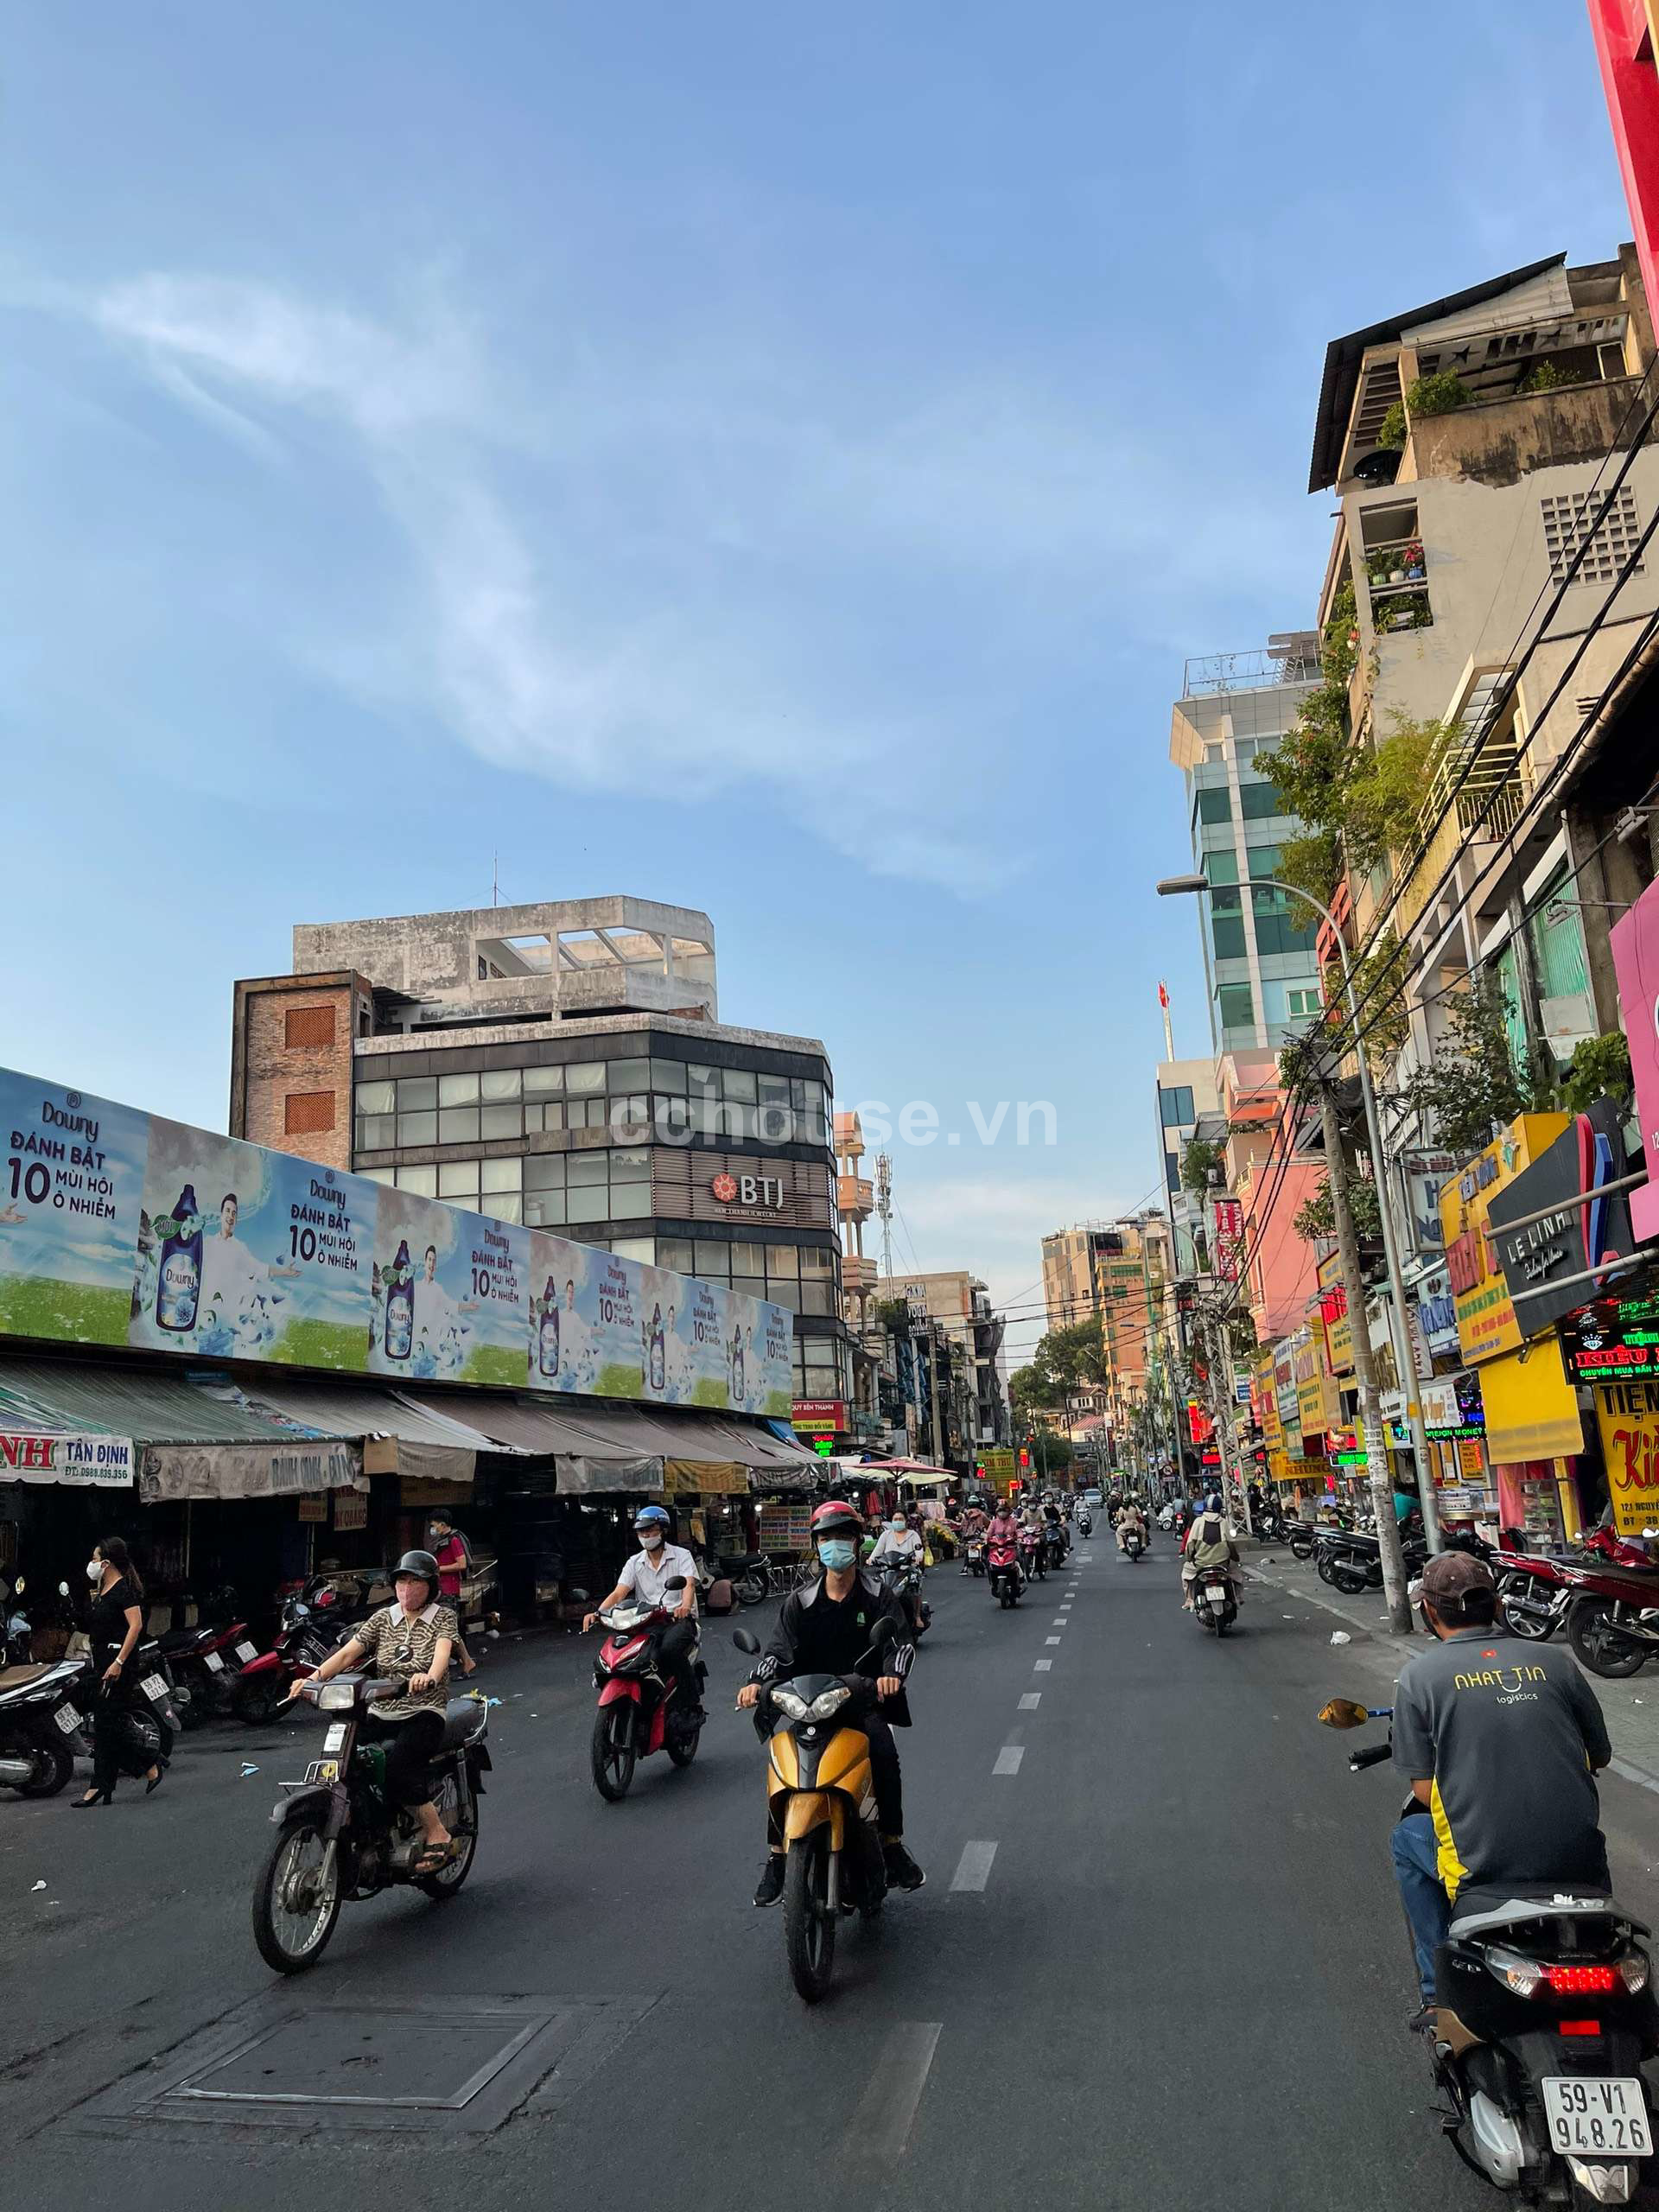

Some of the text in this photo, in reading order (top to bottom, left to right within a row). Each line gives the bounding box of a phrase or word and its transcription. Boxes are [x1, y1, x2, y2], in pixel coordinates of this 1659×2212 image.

[41, 1101, 99, 1143] Downy
[10, 1131, 105, 1172] ĐÁNH BẬT
[8, 1157, 50, 1204] 10
[55, 1169, 113, 1196] MÙI HÔI
[310, 1179, 346, 1211] Downy
[741, 1175, 784, 1209] BTJ
[53, 1190, 116, 1220] Ô NHIỄM
[290, 1204, 351, 1233] ĐÁNH BẬT
[289, 1224, 316, 1262] 10
[319, 1232, 355, 1252] MÙI HÔI
[318, 1249, 358, 1271] Ô NHIỄM
[472, 1249, 495, 1268] ĐÁNH
[166, 1268, 194, 1288] Downy
[472, 1268, 490, 1297] 10
[600, 1298, 613, 1323] 10
[693, 1320, 704, 1342] 10
[766, 1340, 775, 1358] 10
[1614, 1366, 1633, 1375] MUA
[1454, 1427, 1482, 1436] MONEY
[67, 1438, 92, 1462] TÂN
[97, 1445, 128, 1467] ĐỊNH
[1497, 1693, 1538, 1705] logistics
[1559, 2083, 1626, 2114] 59-V1
[1556, 2118, 1644, 2149] 948.26
